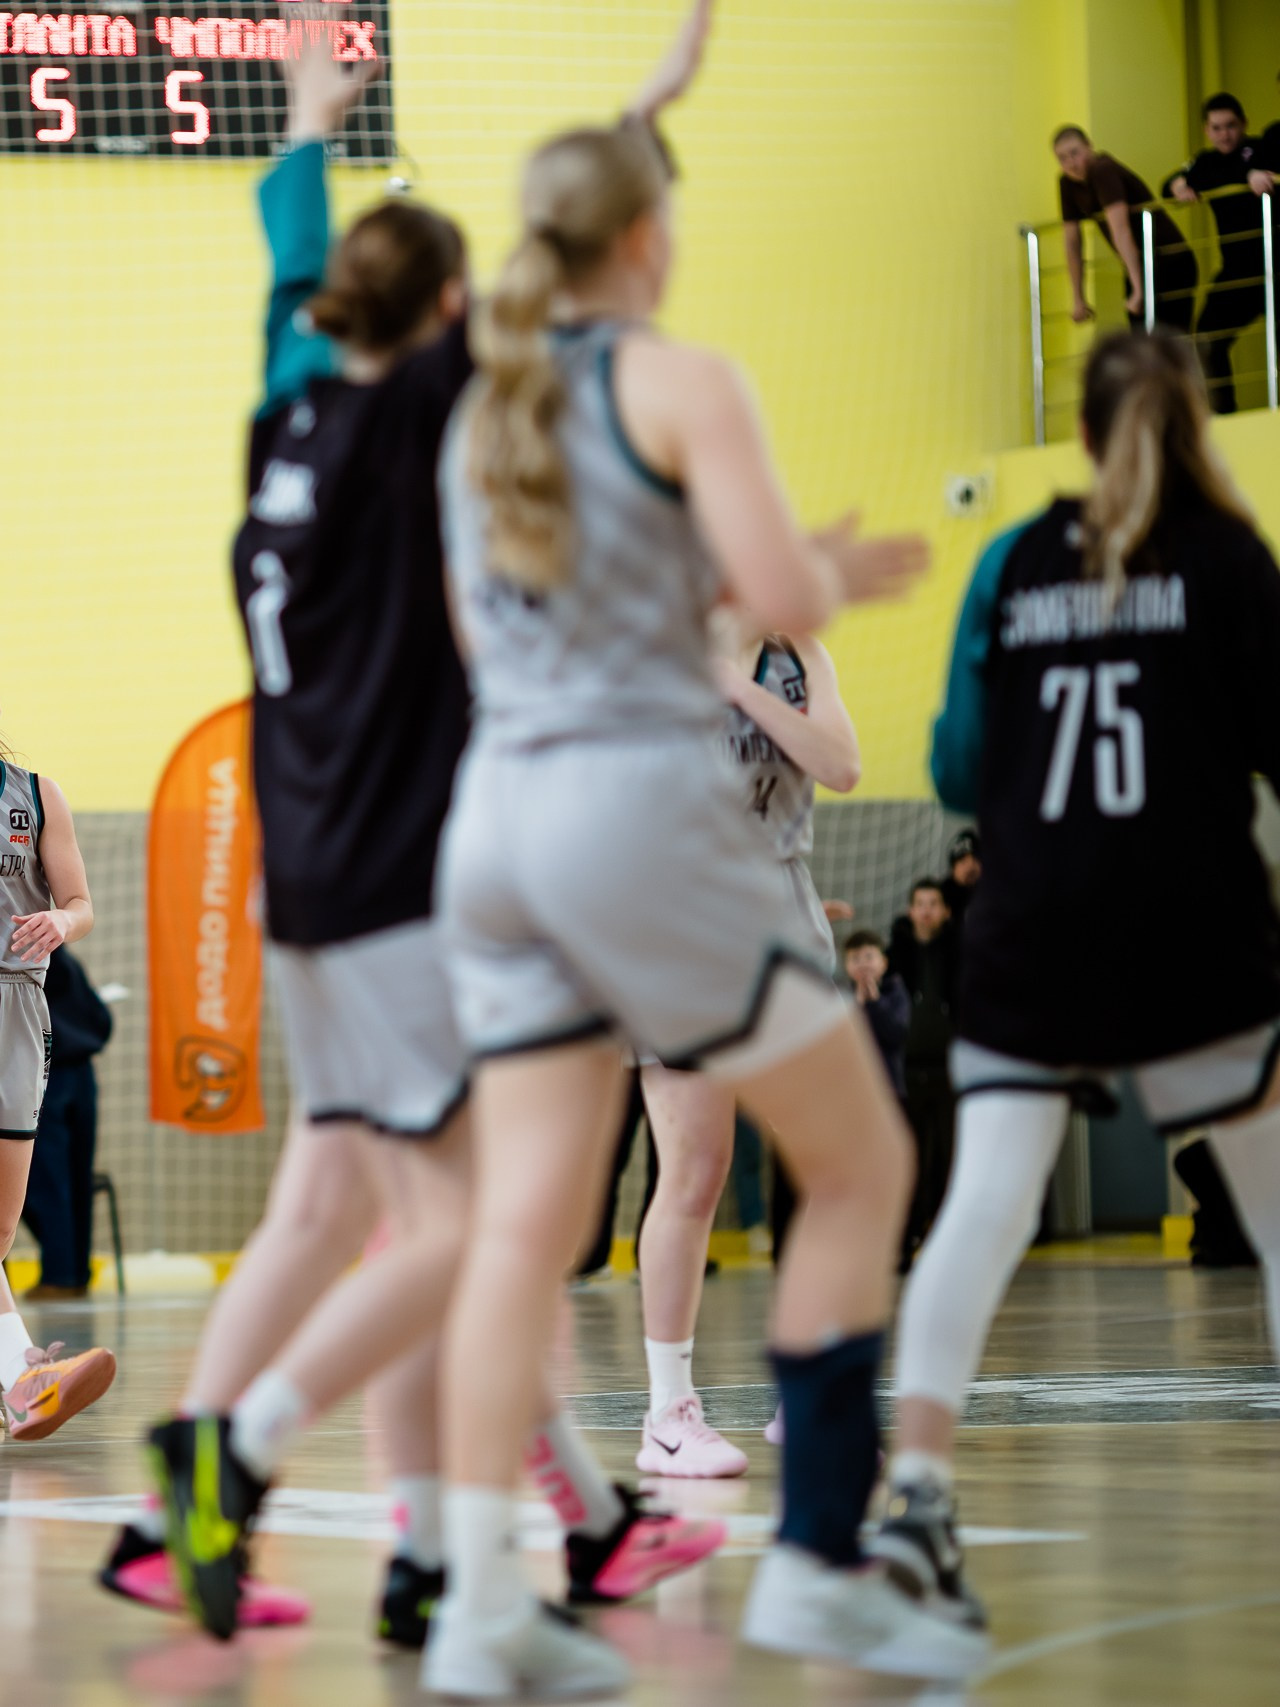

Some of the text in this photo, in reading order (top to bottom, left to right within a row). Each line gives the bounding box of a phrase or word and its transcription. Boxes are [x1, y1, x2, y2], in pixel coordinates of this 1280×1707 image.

[30, 67, 210, 144] 5 5
[1039, 660, 1146, 822] 75
